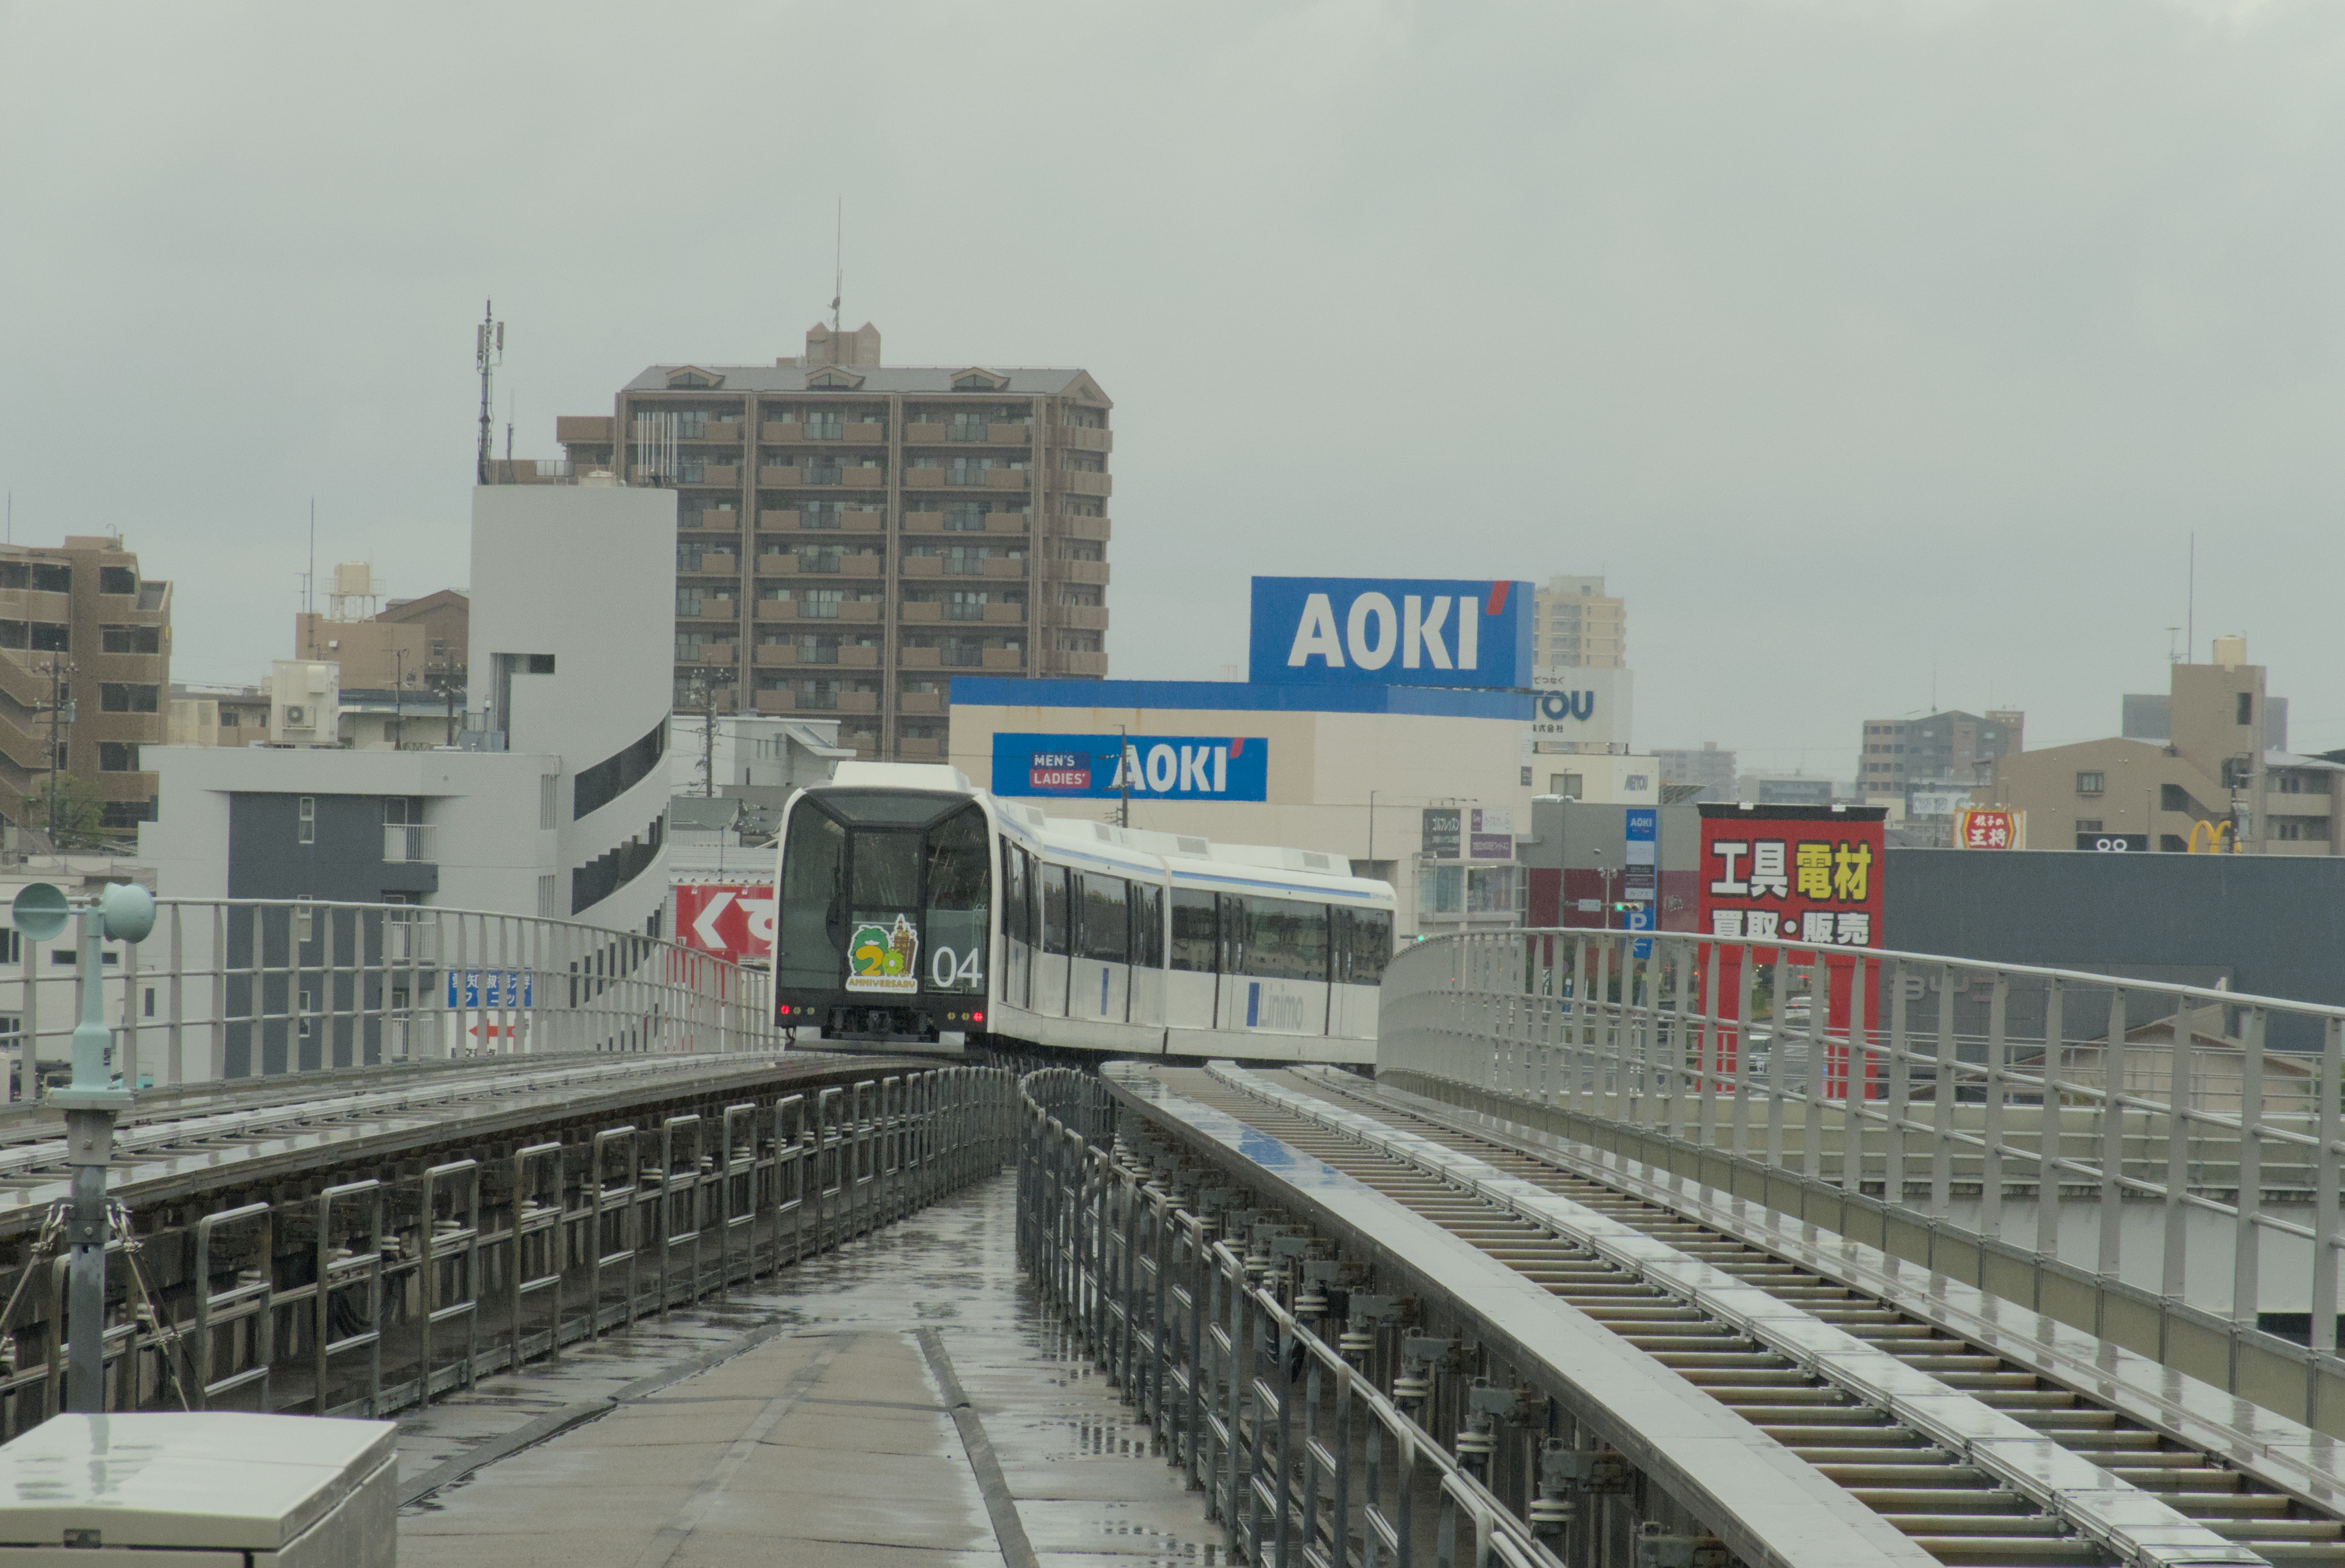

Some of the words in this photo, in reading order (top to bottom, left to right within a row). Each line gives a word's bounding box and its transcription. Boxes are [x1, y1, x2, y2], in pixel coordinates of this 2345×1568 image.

[1288, 592, 1479, 670] AOKI
[1035, 755, 1074, 766] MEN'S
[1112, 745, 1227, 792] AOKI
[1631, 818, 1652, 827] AOKI
[1969, 829, 2006, 847] 王将
[1631, 913, 1647, 930] P
[933, 946, 983, 988] 04
[848, 978, 915, 988] ANNIVERSARY
[1259, 983, 1304, 1030] Linimo
